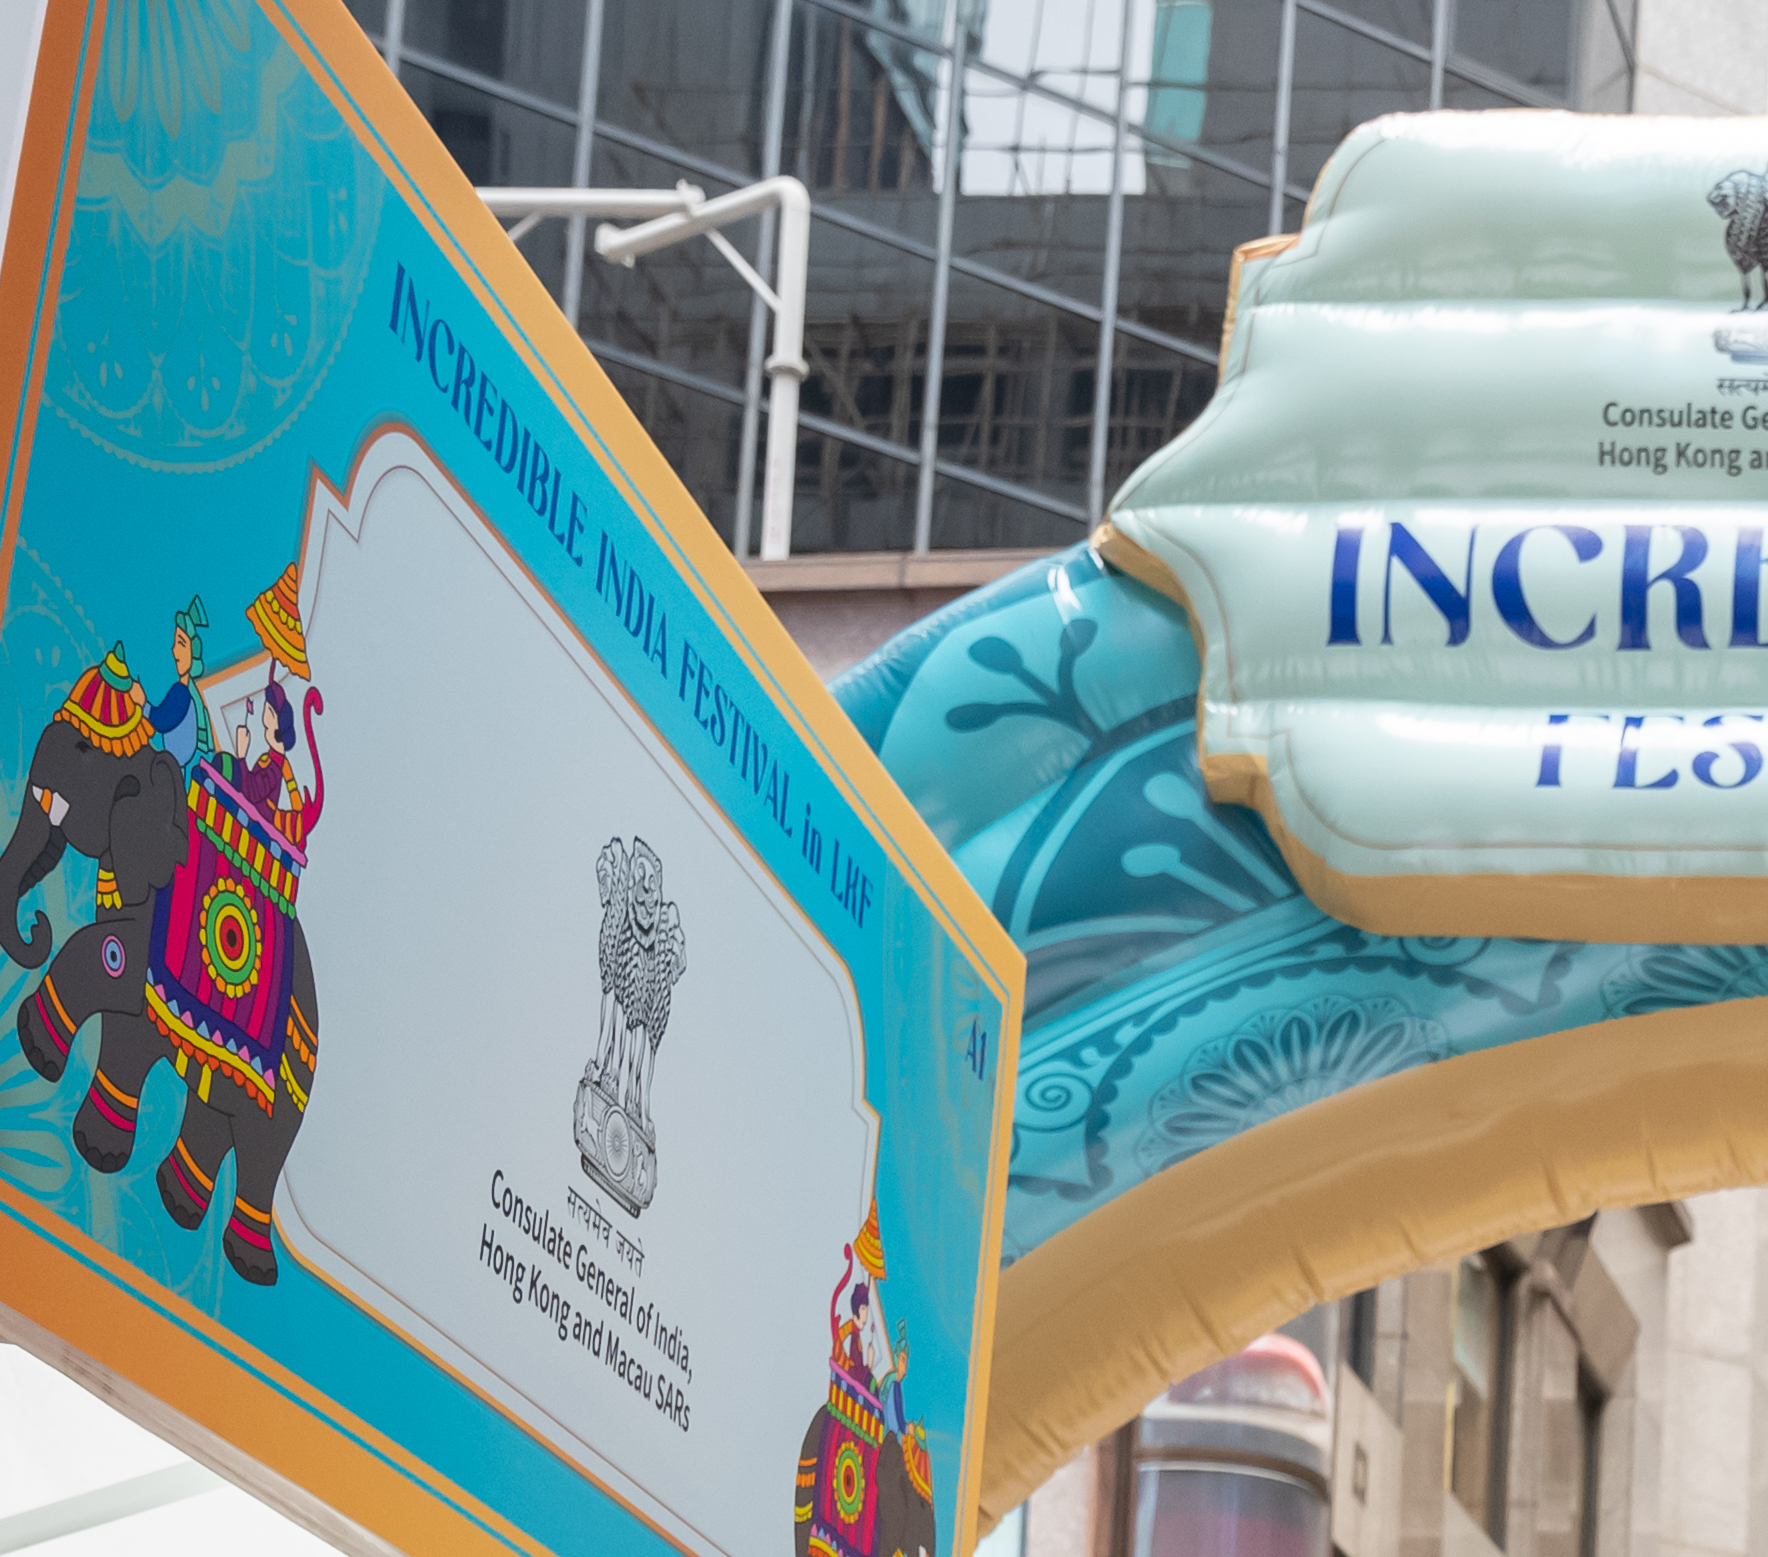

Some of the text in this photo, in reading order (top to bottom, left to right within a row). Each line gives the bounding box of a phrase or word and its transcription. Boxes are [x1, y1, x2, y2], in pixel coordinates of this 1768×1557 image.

[1598, 441, 1668, 476] Hong
[1675, 442, 1742, 477] Kong
[1602, 401, 1733, 430] Consulate
[389, 263, 874, 929] INCREDIBLE INDIA FESTIVAL in LKF
[966, 1018, 987, 1081] A1
[491, 1169, 692, 1386] Consulate General of India,
[567, 1185, 645, 1279] सत्यमेव जयते
[479, 1223, 690, 1433] Hong Kong and Macau SARs
